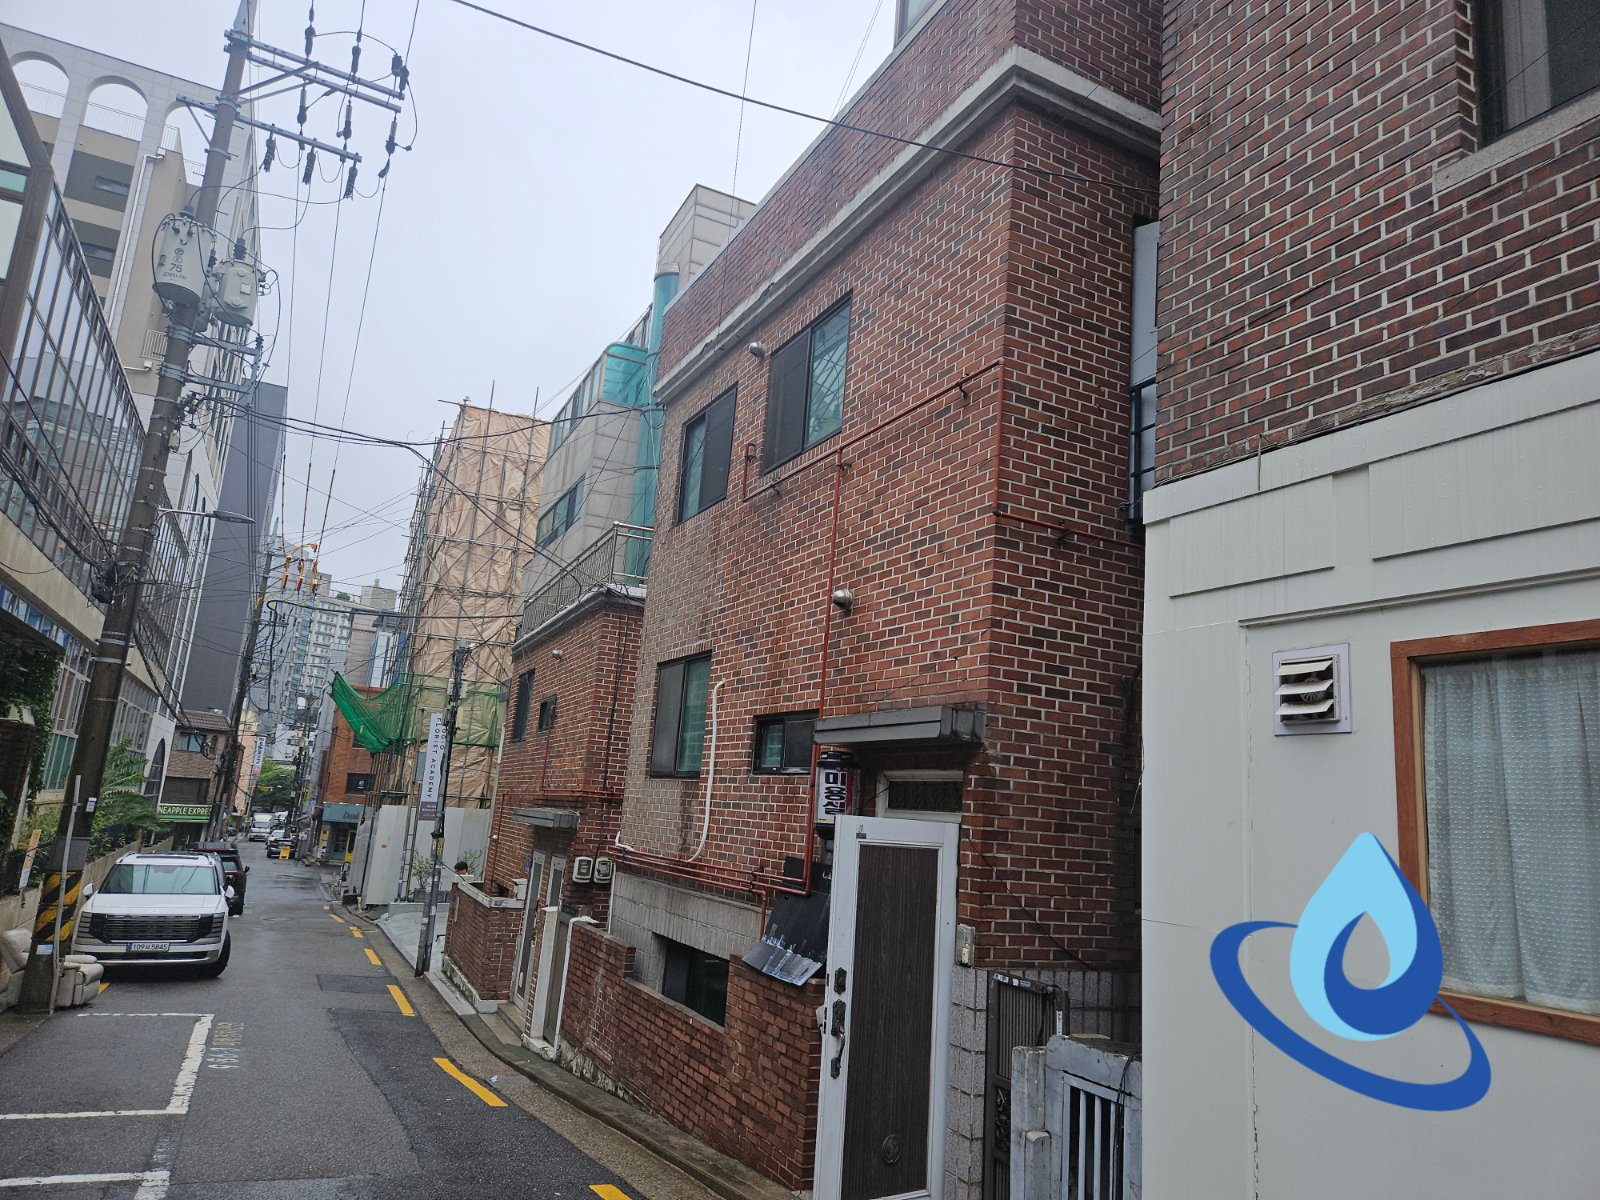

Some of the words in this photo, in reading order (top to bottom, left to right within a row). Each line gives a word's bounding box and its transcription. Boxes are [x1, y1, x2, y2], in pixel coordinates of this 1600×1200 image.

[169, 262, 182, 272] 75
[432, 718, 441, 754] FLORIST
[426, 758, 436, 798] ACADEMY
[822, 772, 846, 815] 미용실
